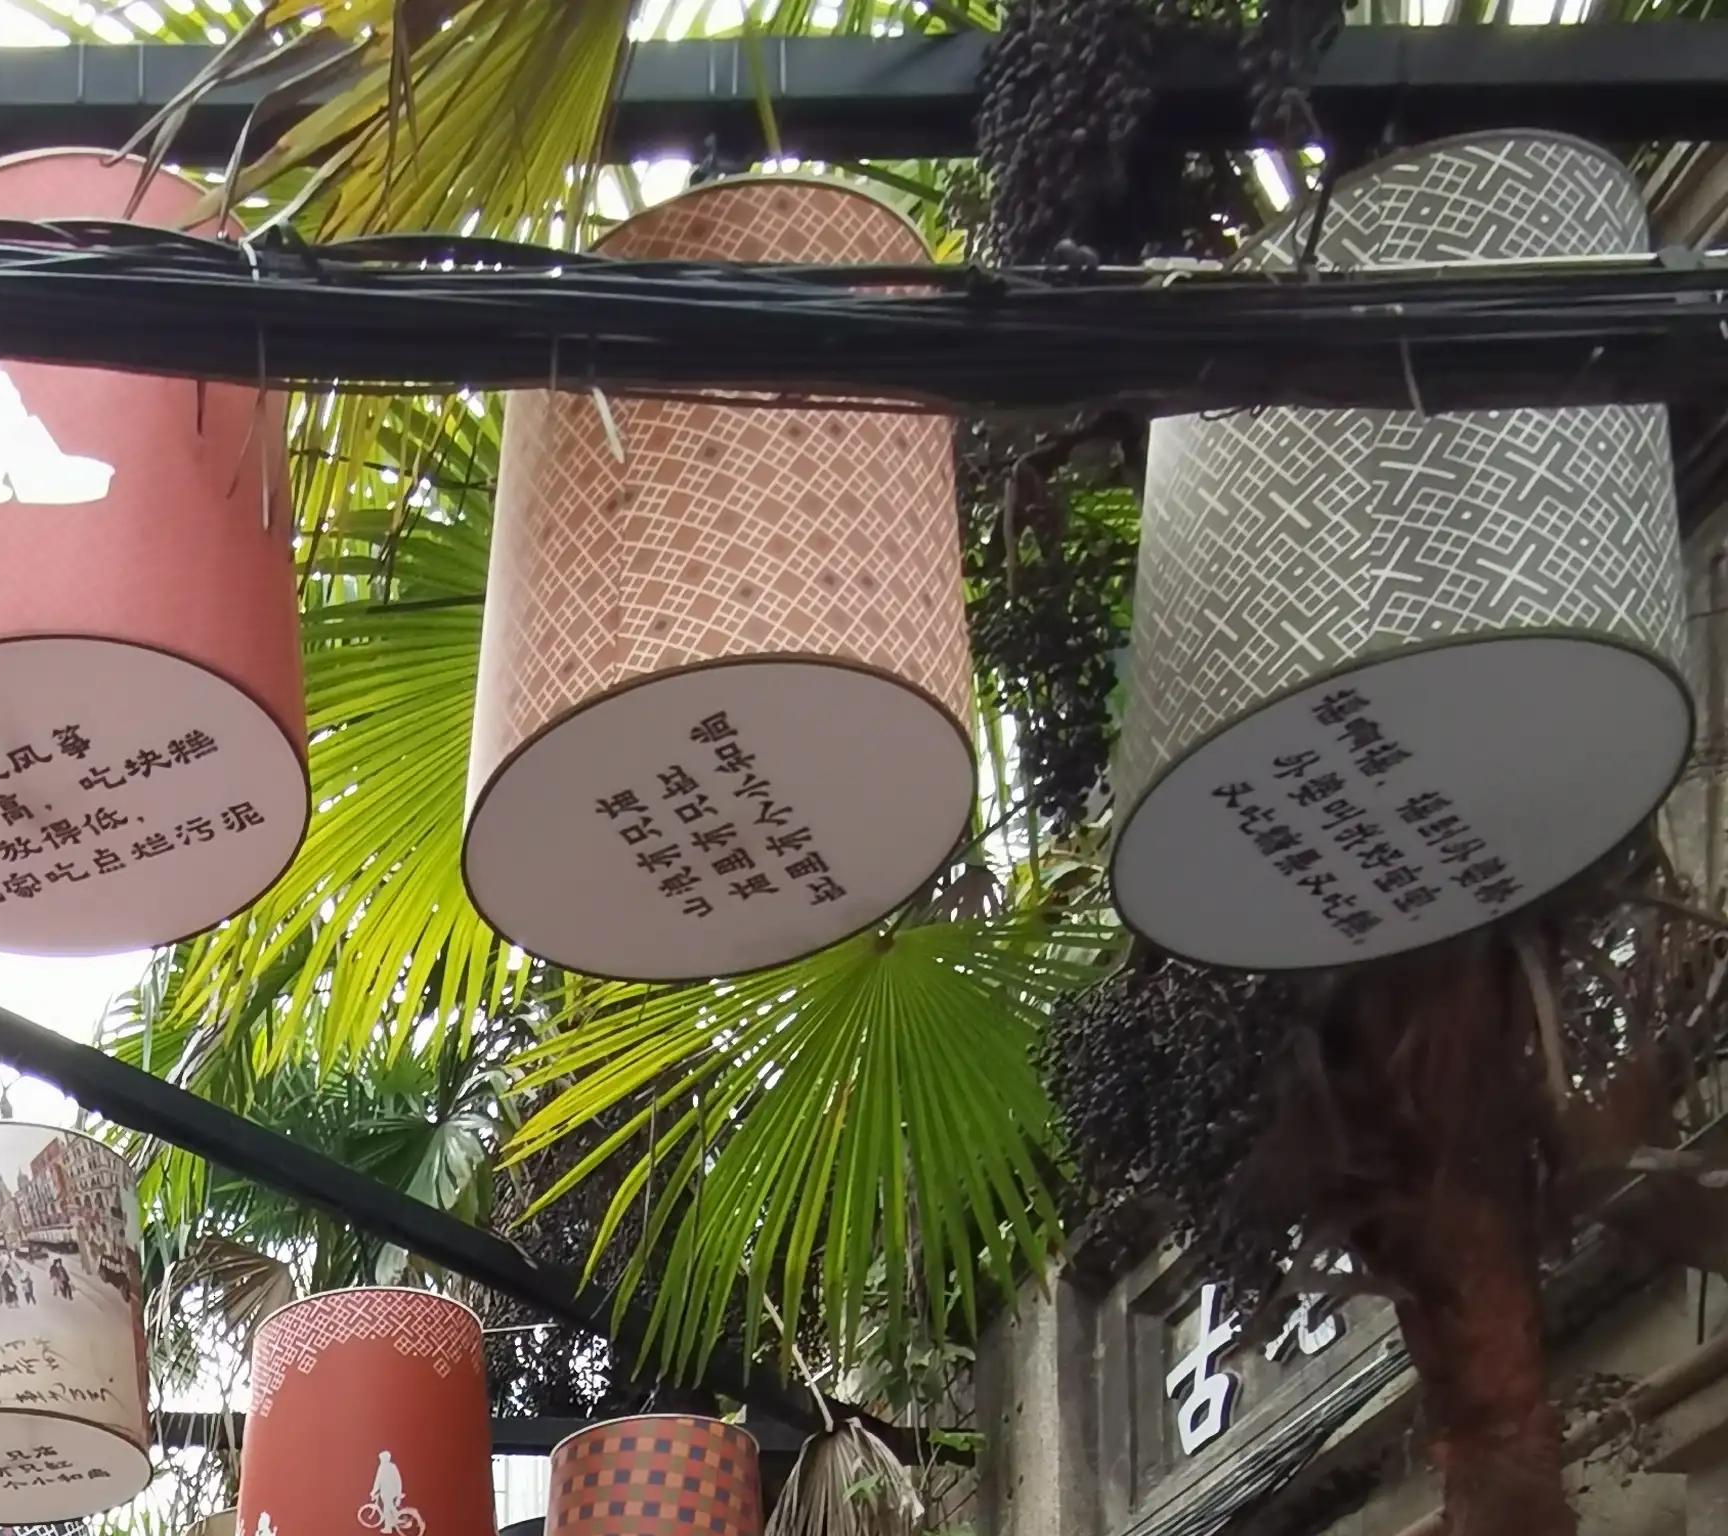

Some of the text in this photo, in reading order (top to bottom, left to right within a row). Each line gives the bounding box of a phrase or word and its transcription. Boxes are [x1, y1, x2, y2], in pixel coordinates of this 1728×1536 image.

[596, 788, 714, 919] 山浪有只庙
[656, 765, 779, 903] 庙里有只缸
[689, 710, 847, 906] 缸里有个小和尚
